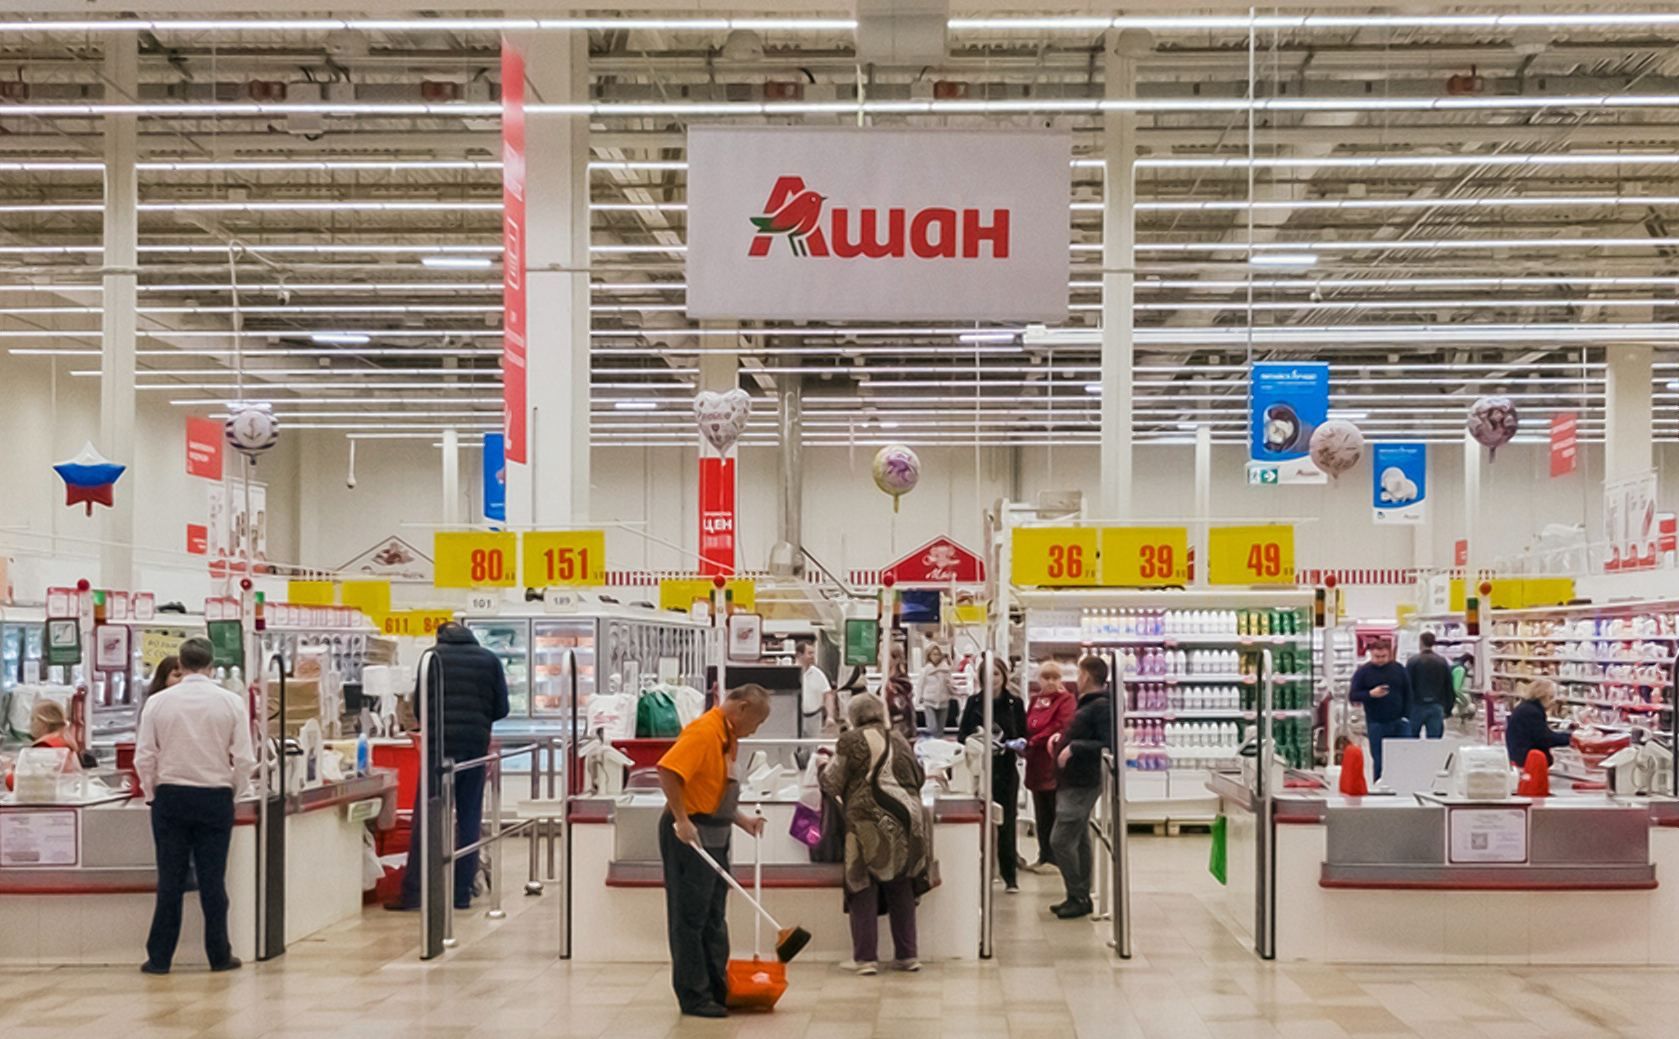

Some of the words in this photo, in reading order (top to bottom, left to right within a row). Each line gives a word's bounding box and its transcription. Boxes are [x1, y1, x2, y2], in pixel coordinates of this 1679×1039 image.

[748, 176, 1009, 259] Ашан
[471, 548, 503, 582] 80
[543, 547, 588, 581] 151
[1048, 545, 1082, 578] 36
[1139, 545, 1173, 578] 39
[1247, 543, 1280, 577] 49
